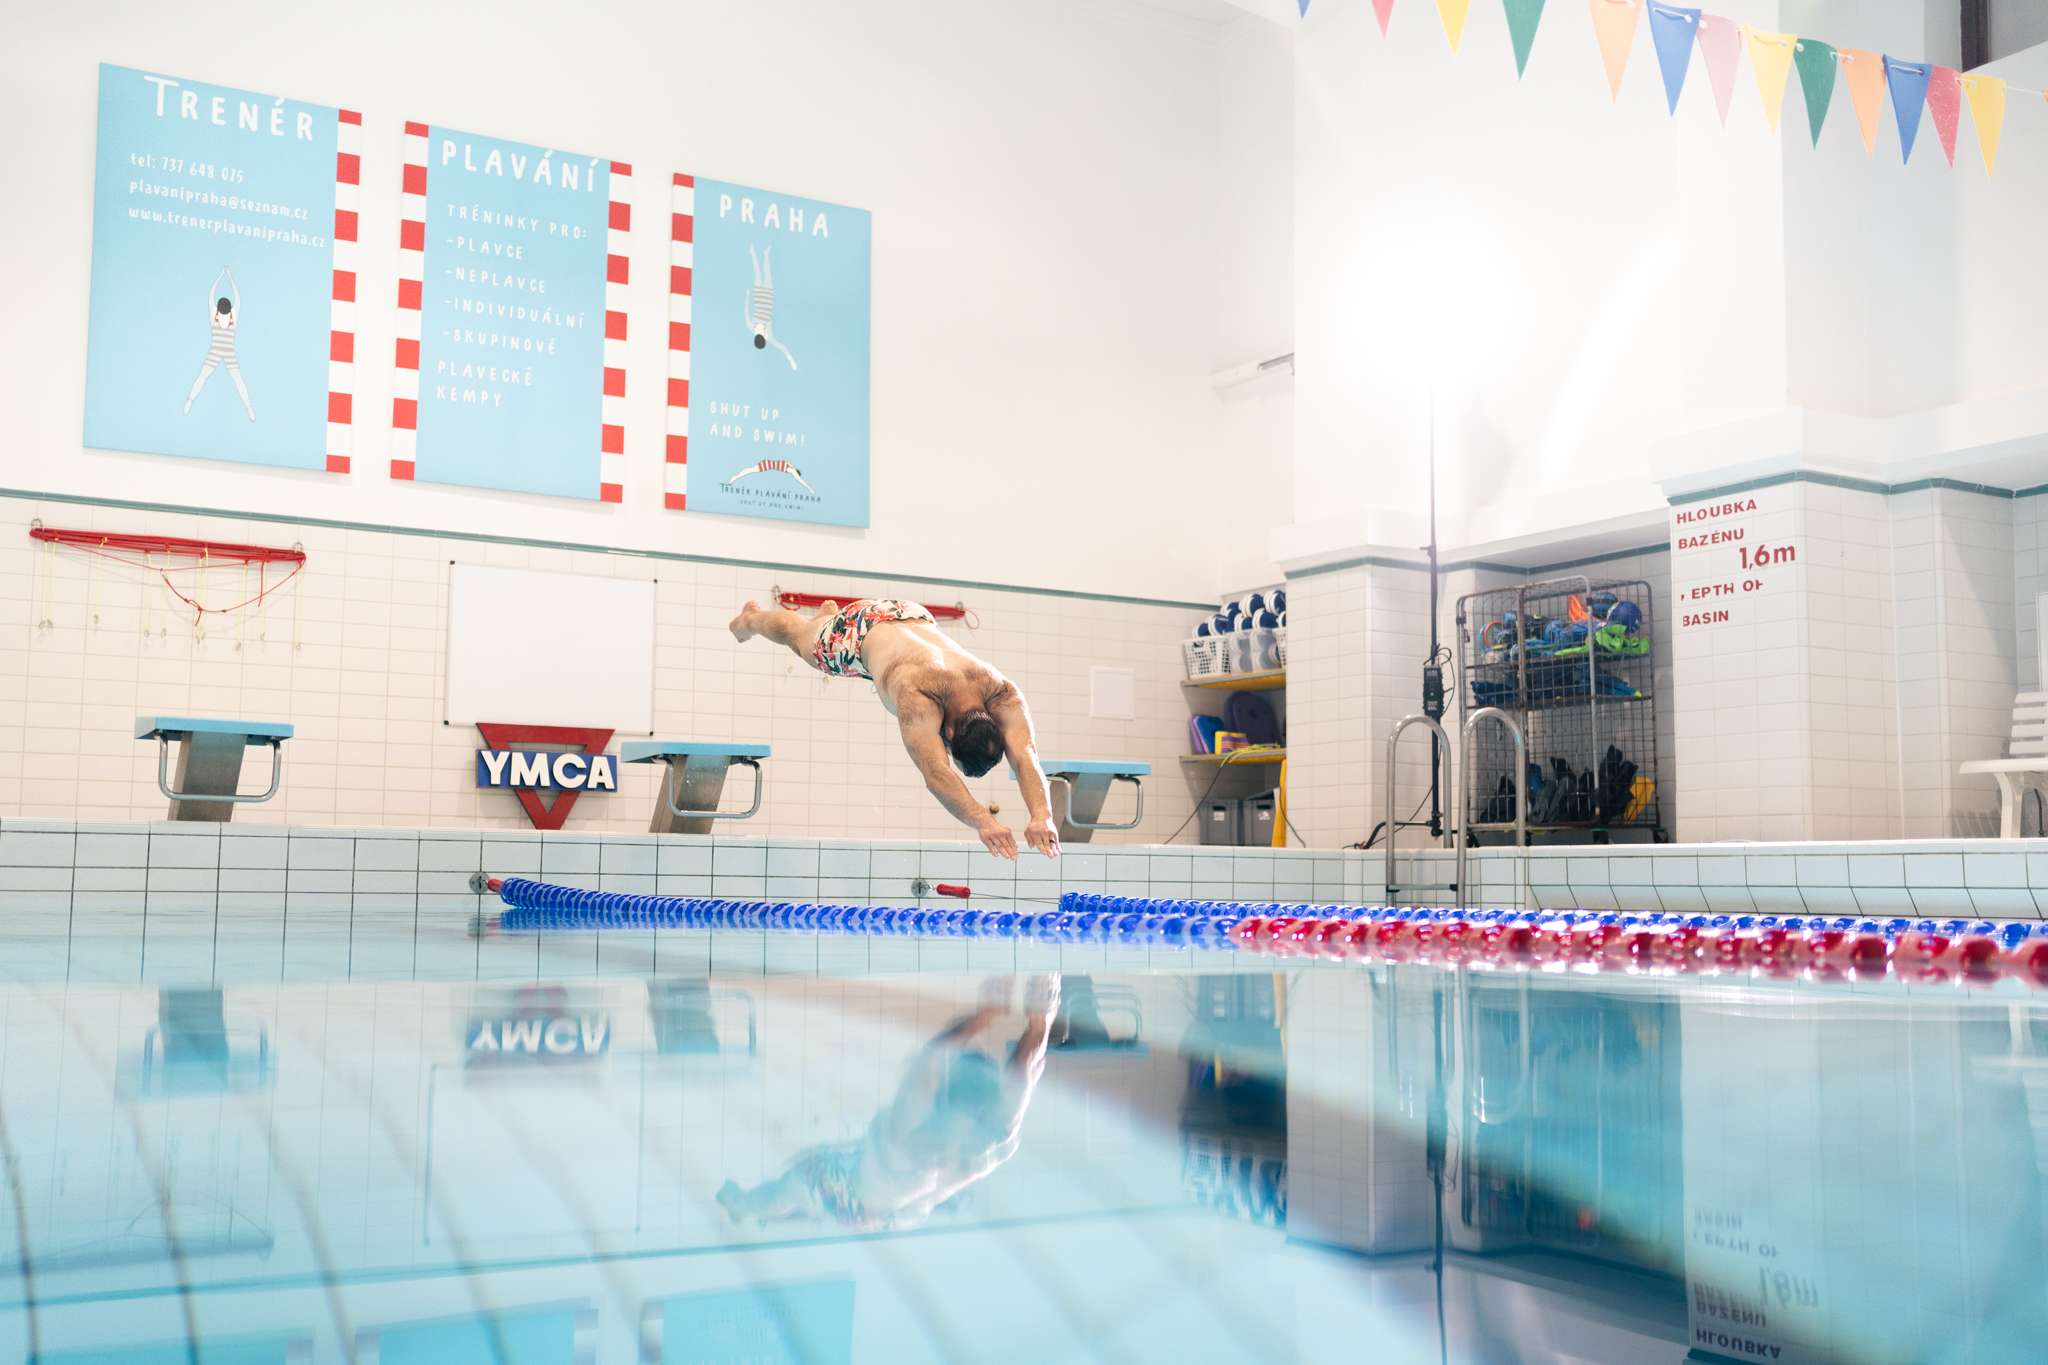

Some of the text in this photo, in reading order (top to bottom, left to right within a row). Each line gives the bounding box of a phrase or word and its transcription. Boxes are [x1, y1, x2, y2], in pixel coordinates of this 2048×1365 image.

[131, 152, 244, 184] tel: 737 648 075
[442, 139, 599, 192] PLAVÁNÍ
[129, 179, 308, 220] plavanipraha@seznam.cz
[128, 207, 326, 248] www.trenerplavanipraha.cz
[447, 204, 587, 239] TRÉNINKY PRO:
[719, 193, 828, 238] PRAHA
[438, 360, 532, 386] PLAVECKÉ
[436, 385, 502, 407] KEMPY
[709, 401, 780, 421] SHUT UP
[709, 423, 805, 447] AND SWIM!
[755, 489, 791, 500] PLAVÁNÍ
[794, 494, 822, 503] PRAHA
[1676, 499, 1757, 525] HLOUBKA
[1678, 528, 1744, 550] BAZÉNU
[1680, 582, 1735, 601] EPTH
[1682, 610, 1729, 627] BASIN
[480, 750, 615, 790] YMCA
